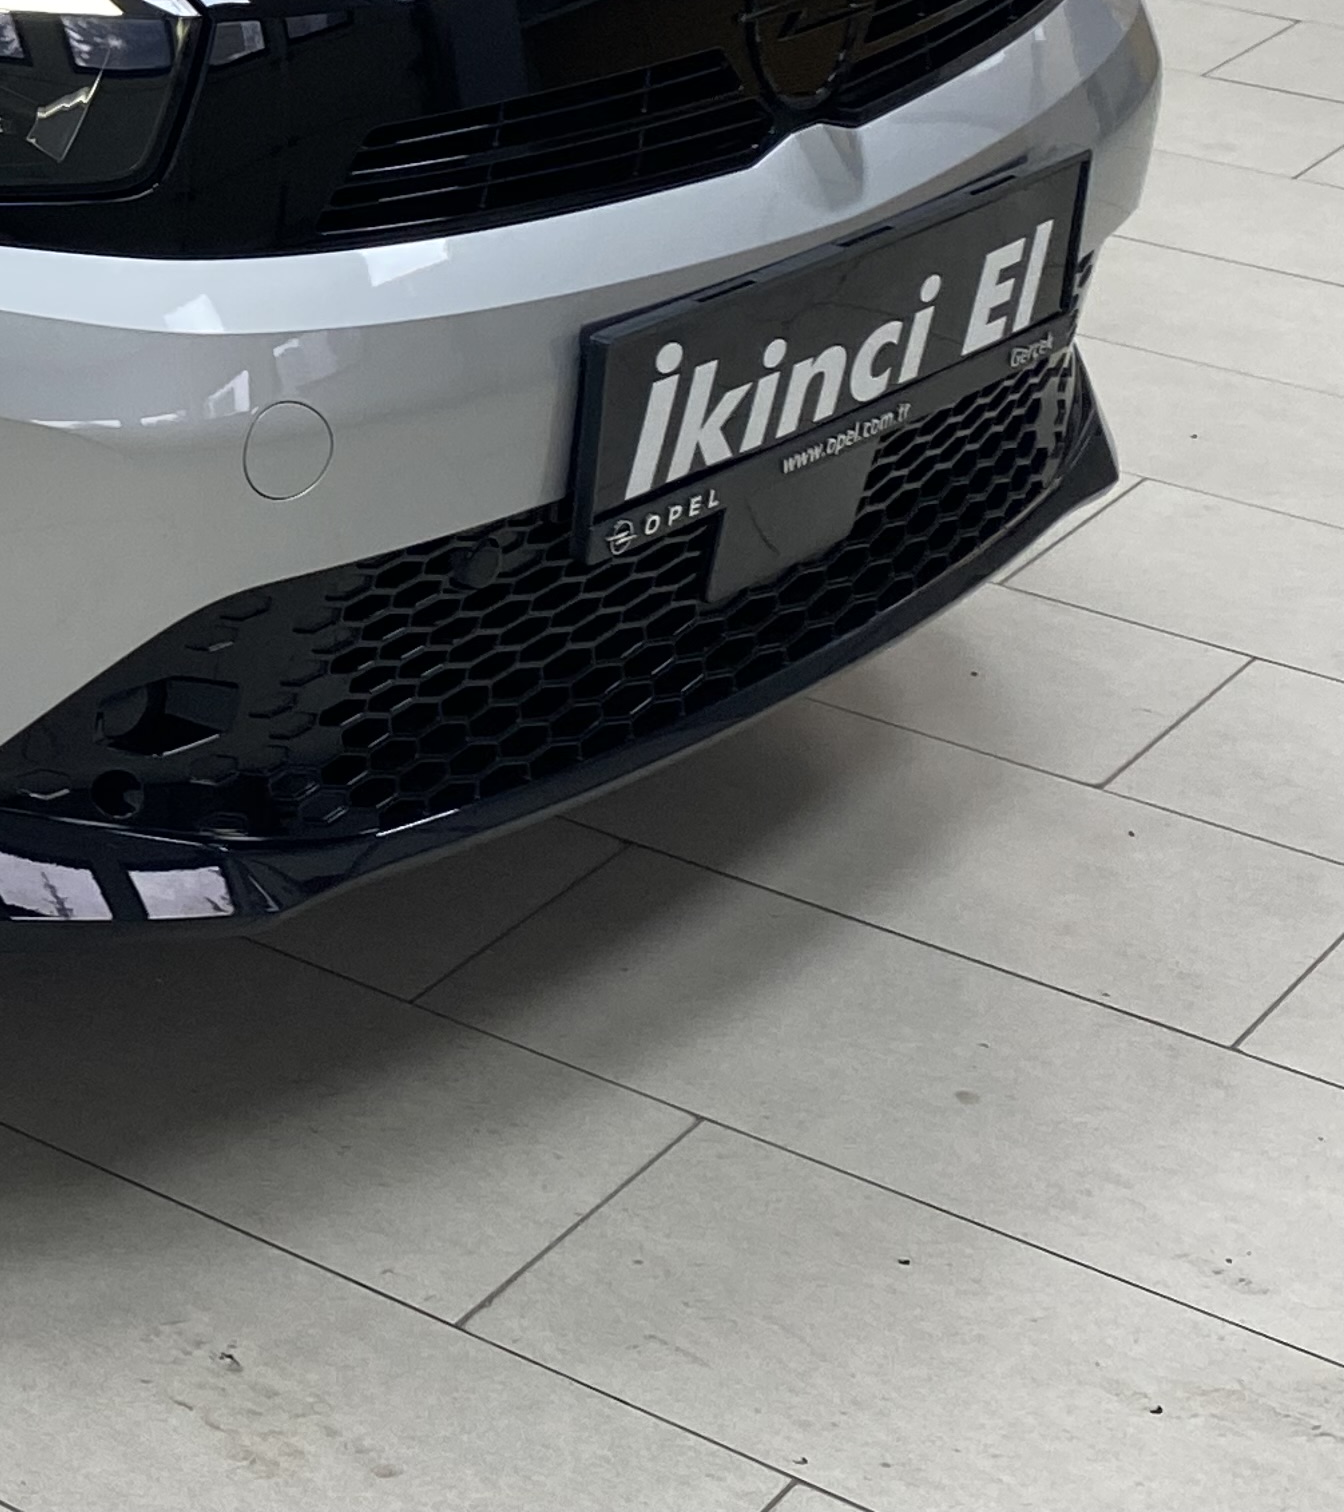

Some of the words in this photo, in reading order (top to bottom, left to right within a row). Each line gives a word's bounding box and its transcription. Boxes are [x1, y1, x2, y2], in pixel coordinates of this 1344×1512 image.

[624, 274, 942, 501] İkinci
[961, 219, 1054, 356] El
[783, 403, 911, 474] www.opel.com.tr
[644, 489, 720, 536] OPEL
